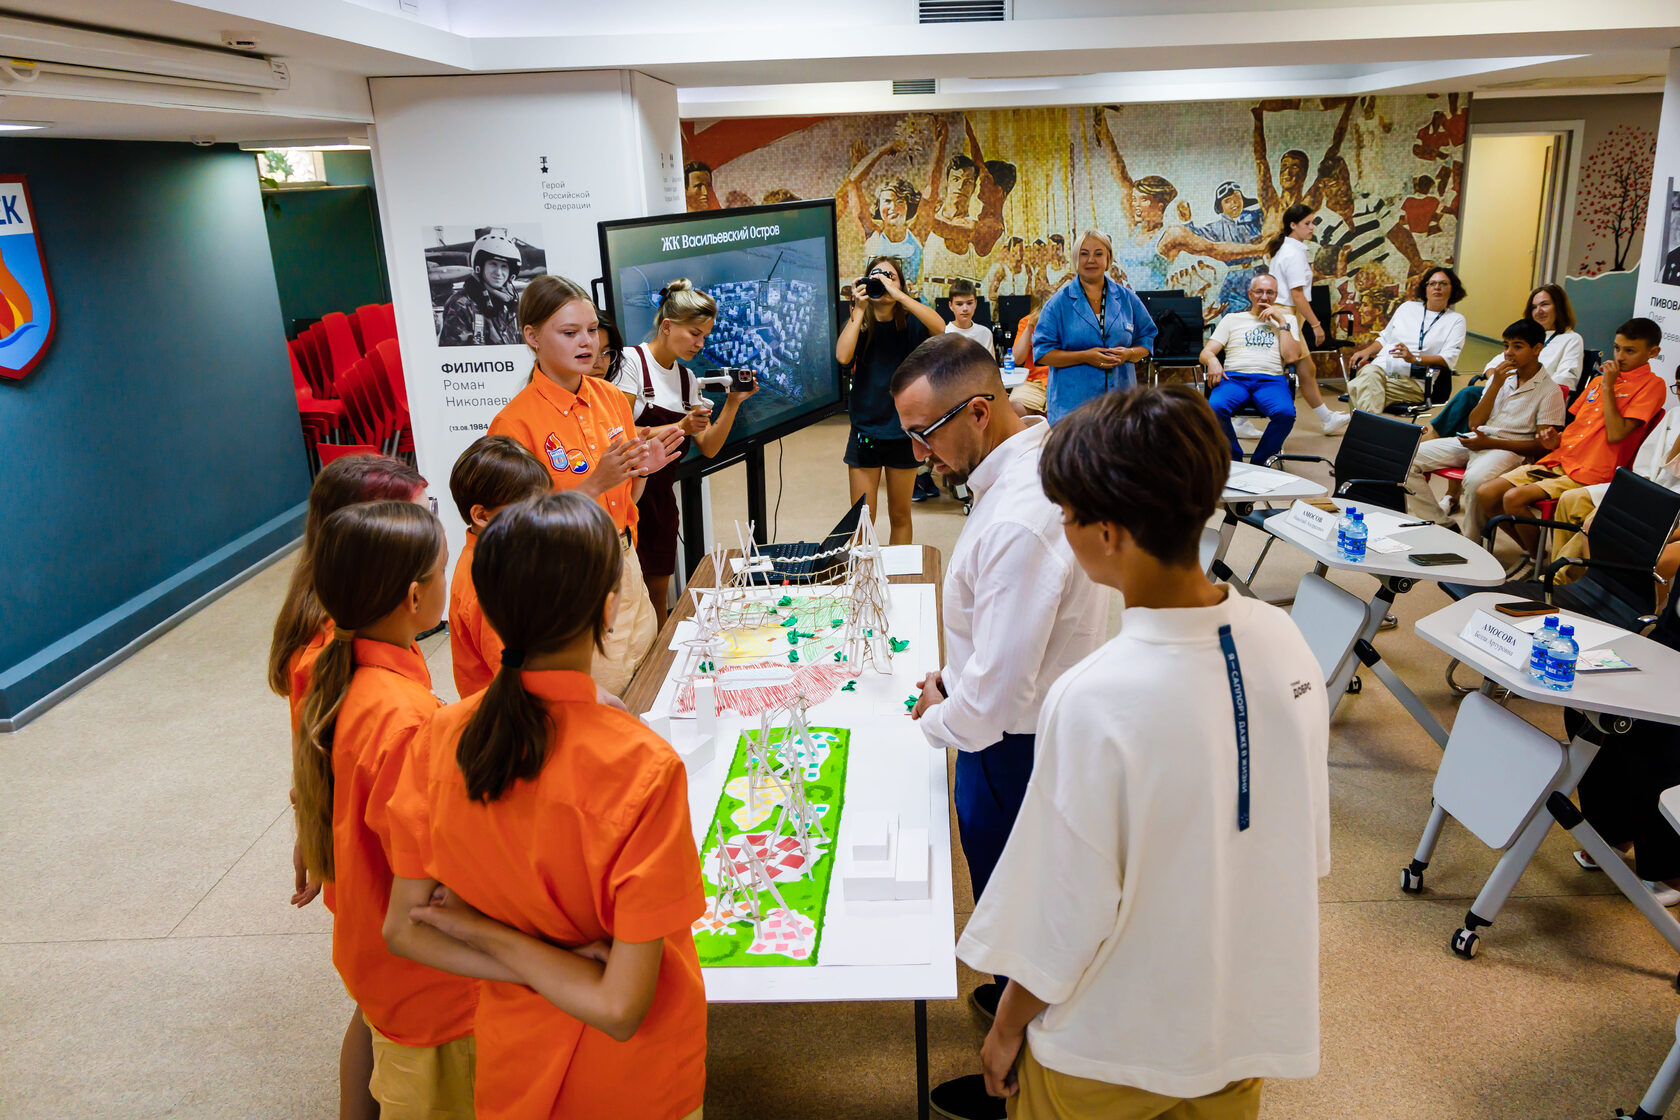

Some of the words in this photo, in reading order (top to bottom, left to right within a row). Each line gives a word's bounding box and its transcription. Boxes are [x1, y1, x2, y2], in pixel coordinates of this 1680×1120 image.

[541, 181, 565, 190] Герой
[543, 191, 590, 199] Российской
[544, 203, 591, 211] Федерации
[661, 235, 681, 251] ЖК
[682, 226, 749, 249] Васильевский
[750, 225, 780, 241] Остров
[441, 361, 515, 374] ФИЛИПОВ
[443, 379, 485, 391] Роман
[1481, 623, 1517, 647] АМОСОВА
[1238, 721, 1248, 750] ДАЖЕ
[1241, 757, 1249, 794] ЖИЗНИ
